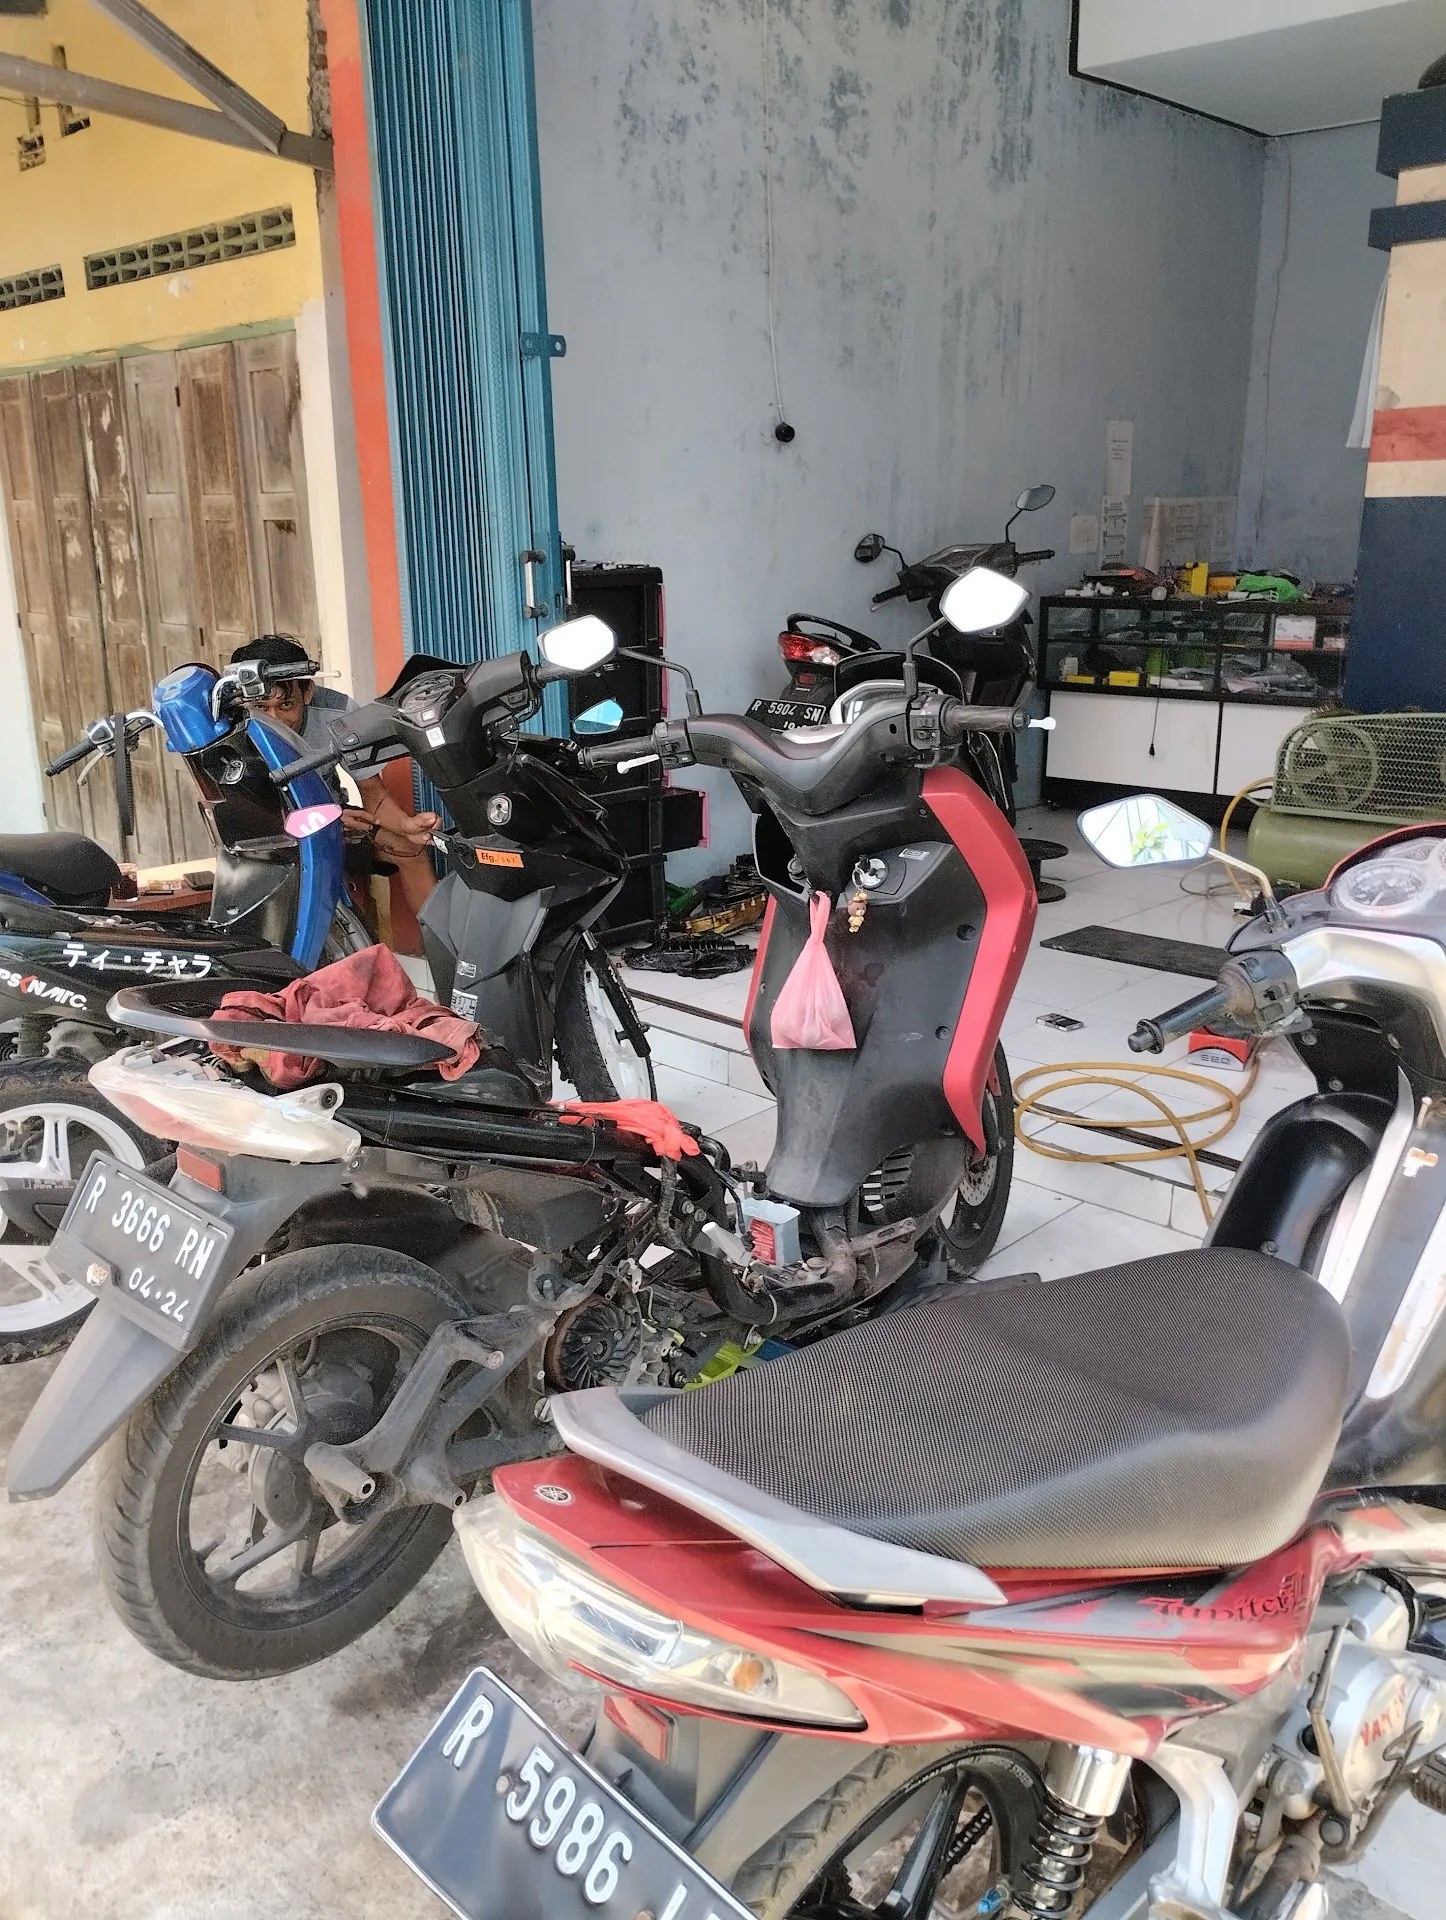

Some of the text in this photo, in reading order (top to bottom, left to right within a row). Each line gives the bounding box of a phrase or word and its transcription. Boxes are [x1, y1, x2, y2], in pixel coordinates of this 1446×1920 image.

[751, 700, 822, 722] R 5904 SN
[62, 943, 212, 978] ティ・チャラ
[85, 1175, 215, 1280] R 3666 RN
[442, 1695, 633, 1904] R 5986
